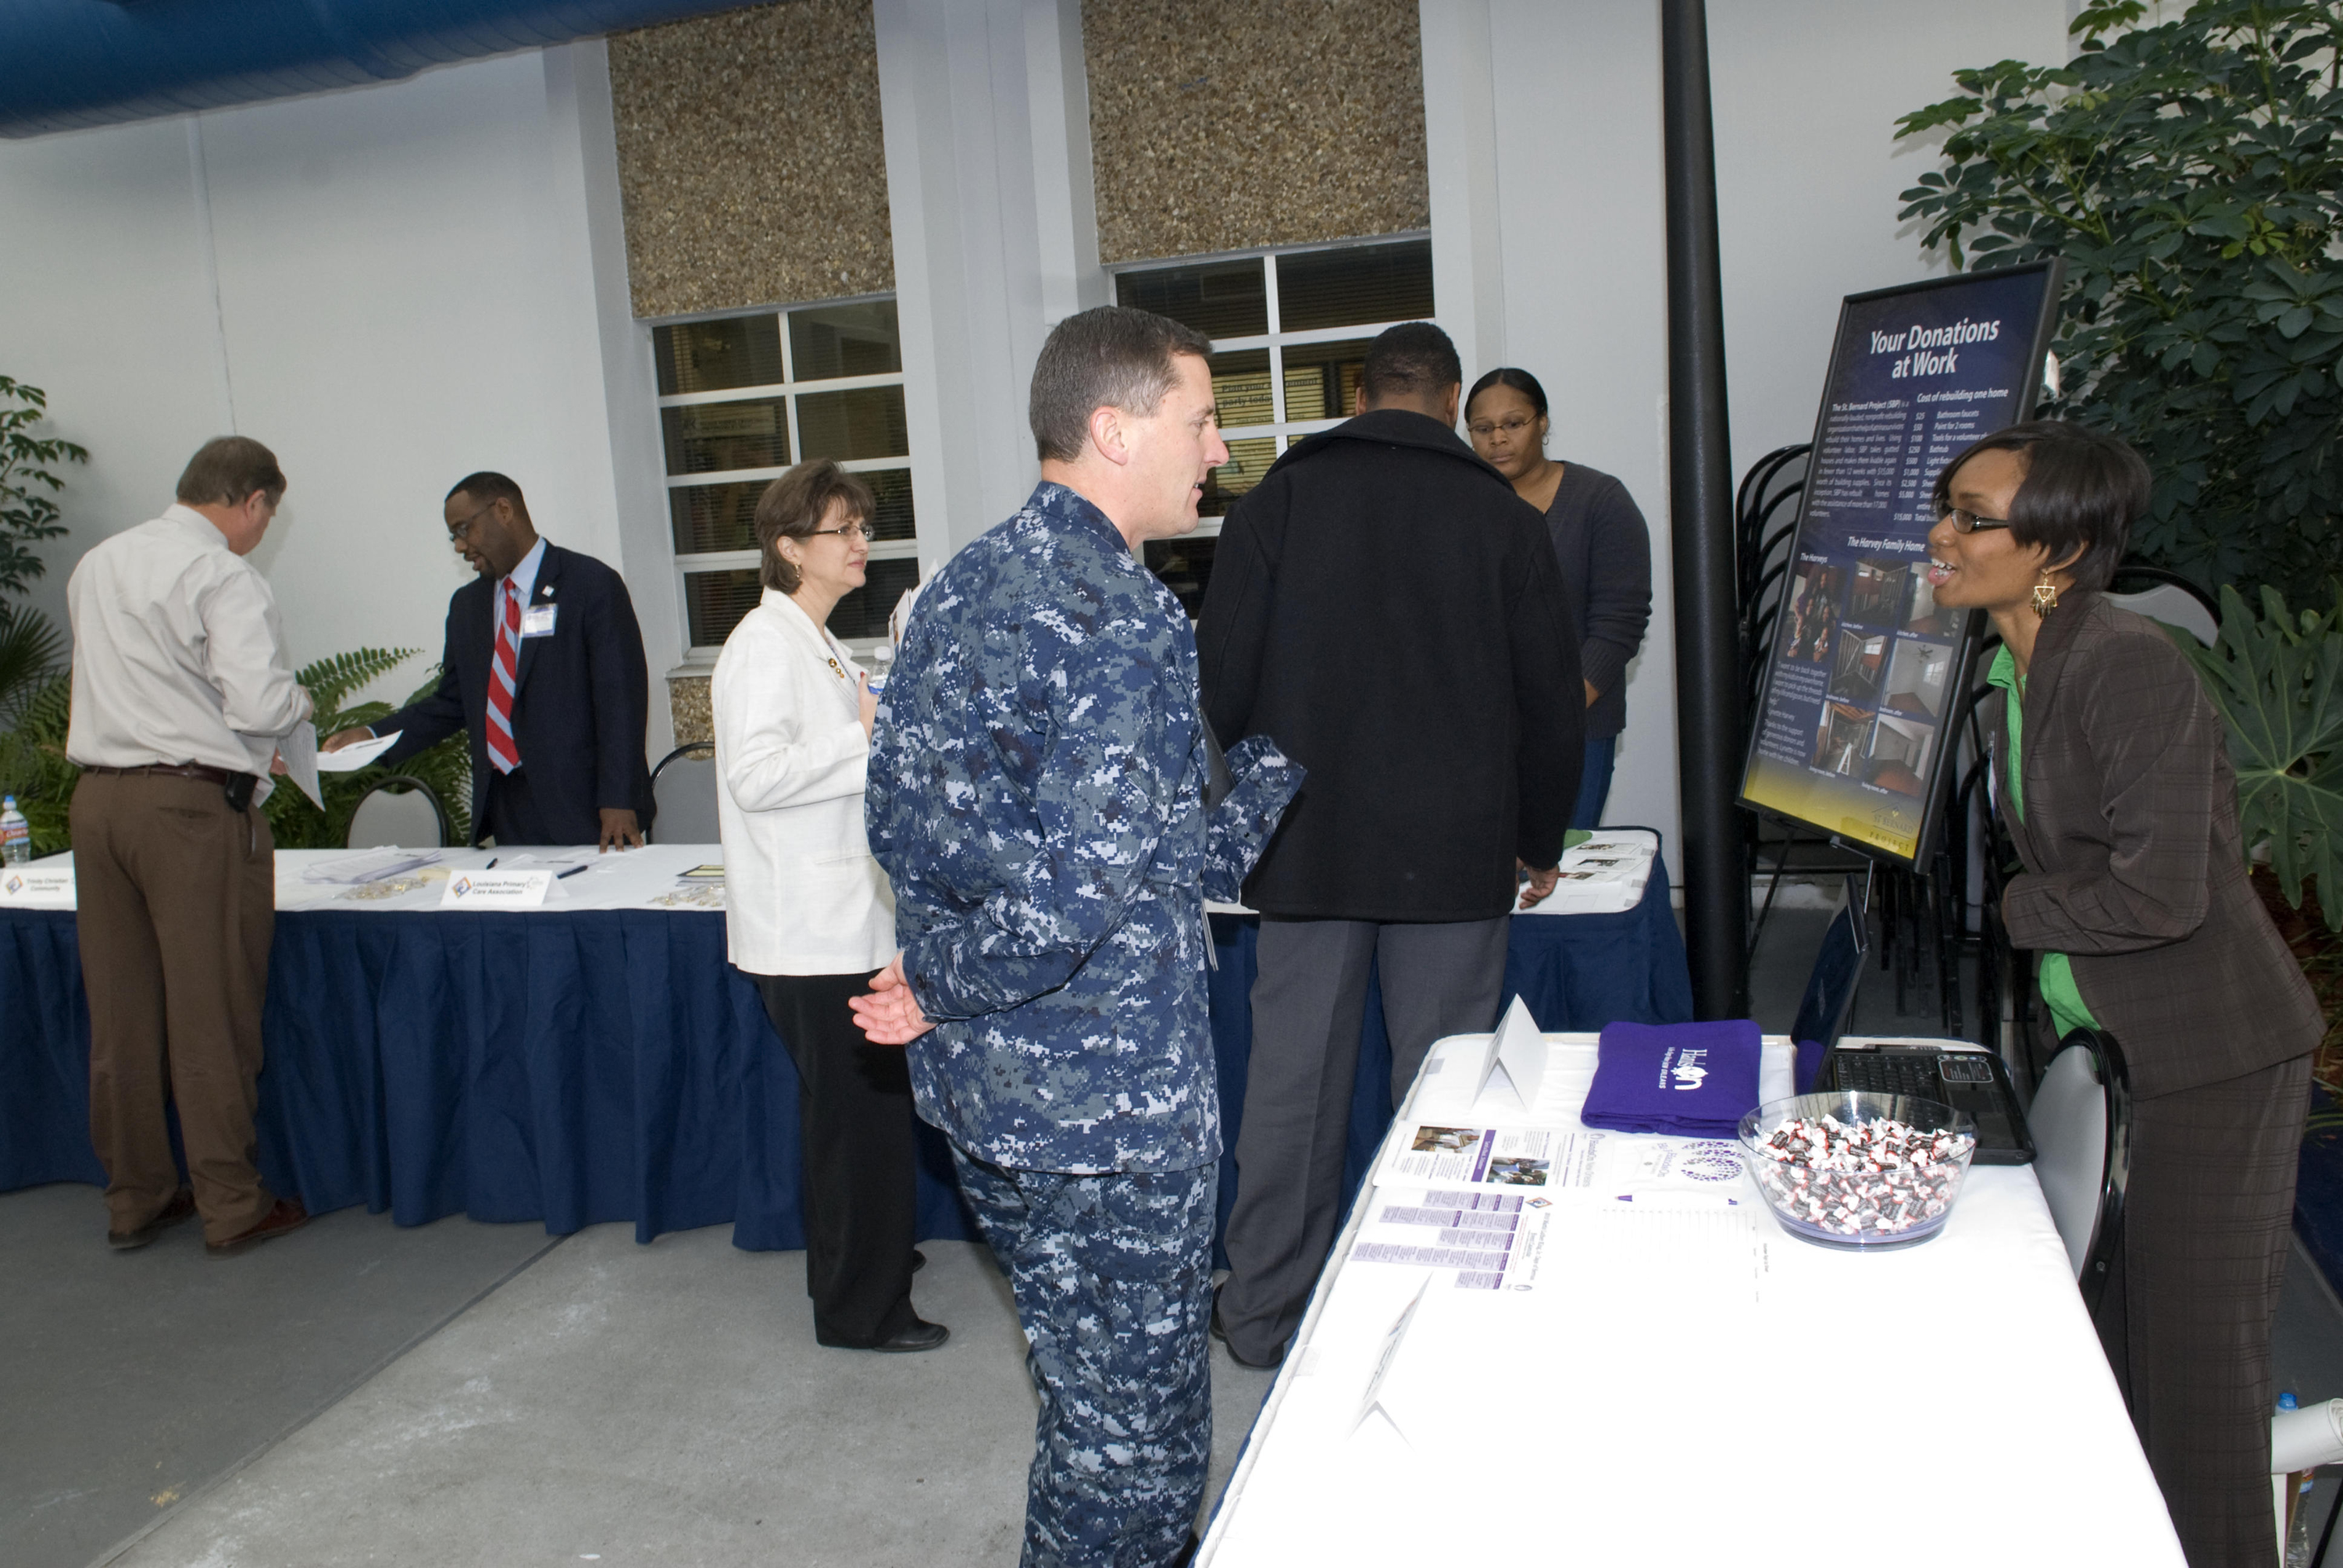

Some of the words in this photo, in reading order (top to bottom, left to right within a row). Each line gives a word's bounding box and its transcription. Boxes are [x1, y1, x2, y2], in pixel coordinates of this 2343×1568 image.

[1870, 330, 1906, 355] Your
[1906, 317, 2000, 351] Donations
[1892, 355, 1911, 379] at
[1912, 347, 1959, 377] Work
[1221, 384, 1243, 393] Plan
[1917, 393, 1931, 403] Cost
[1931, 391, 1940, 402] of
[1938, 390, 1974, 402] rebuilding
[1974, 390, 1988, 399] one
[1988, 388, 2009, 398] home
[1847, 536, 1860, 547] The
[1859, 536, 1882, 551] Harvey
[1882, 538, 1905, 553] Family
[1904, 540, 1926, 552] Home
